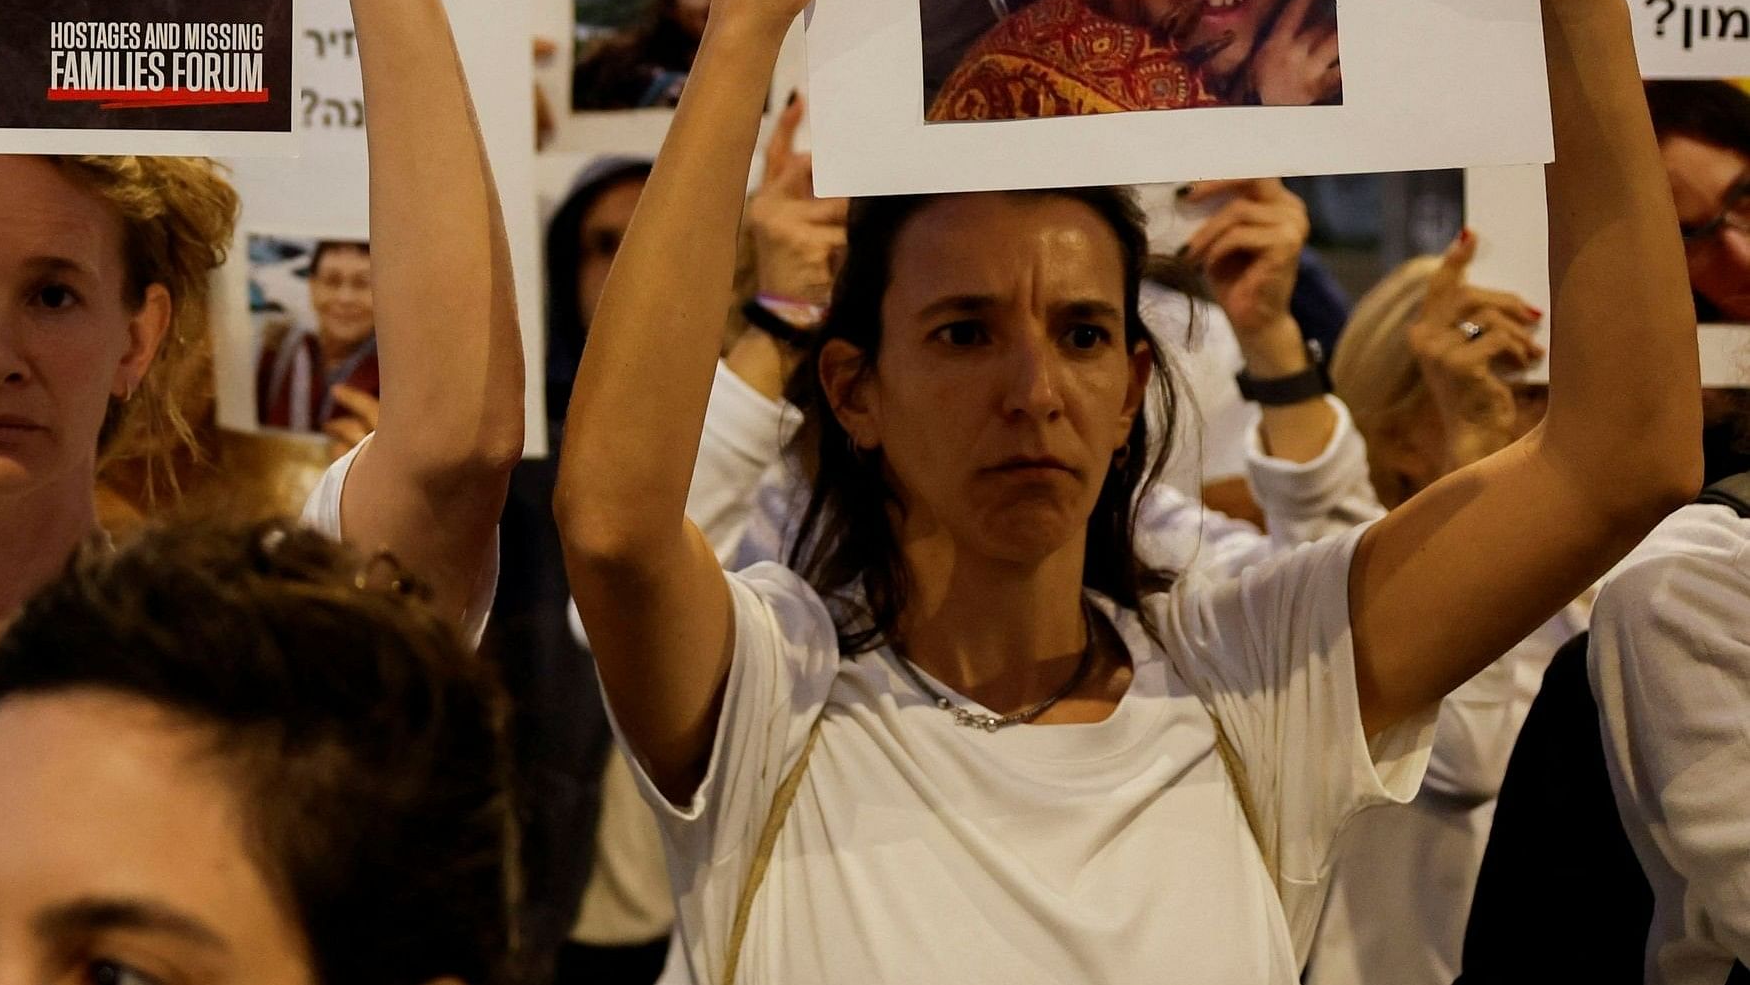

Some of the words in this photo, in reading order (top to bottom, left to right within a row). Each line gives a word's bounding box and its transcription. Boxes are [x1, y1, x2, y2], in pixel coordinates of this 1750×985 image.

[51, 21, 140, 50] HOSTAGES
[144, 22, 180, 50] AND
[184, 23, 263, 51] MISSING
[51, 50, 165, 92] FAMILIES
[172, 51, 263, 93] FORUM
